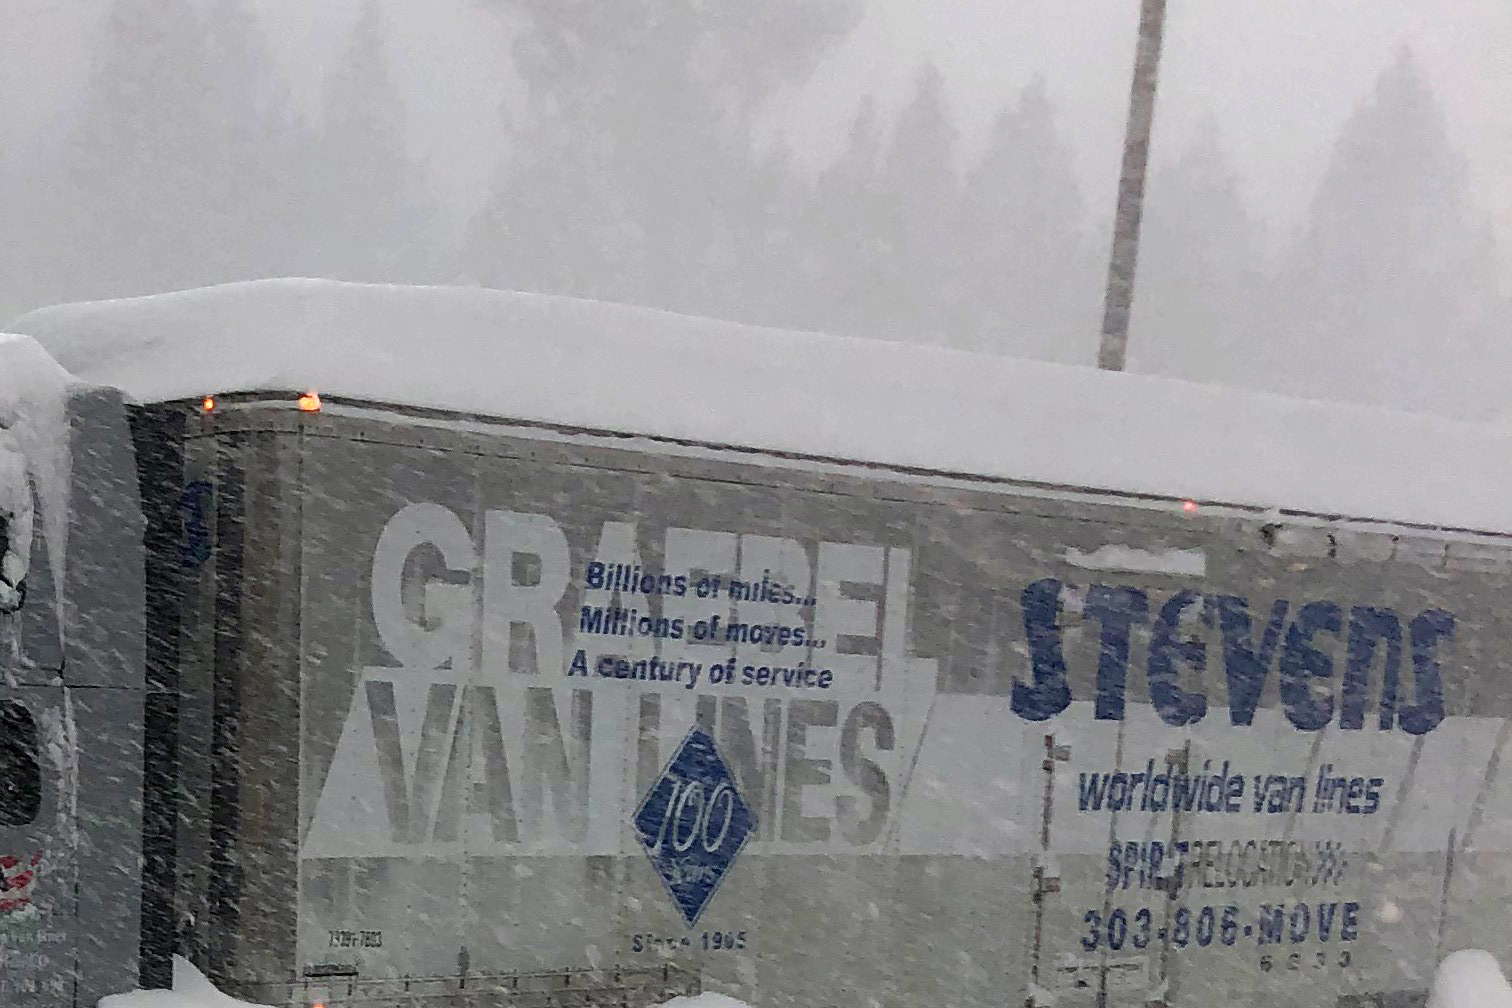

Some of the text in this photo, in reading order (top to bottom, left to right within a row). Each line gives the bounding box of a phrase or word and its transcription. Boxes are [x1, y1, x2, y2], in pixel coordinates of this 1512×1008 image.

[586, 560, 688, 597] Billions
[695, 574, 721, 599] of
[579, 605, 685, 640] Millions
[692, 614, 721, 640] of
[567, 649, 834, 690] A century of service
[1010, 577, 1457, 735] STEVENS
[1079, 757, 1385, 814] worldwide van lines
[647, 776, 734, 856] 100
